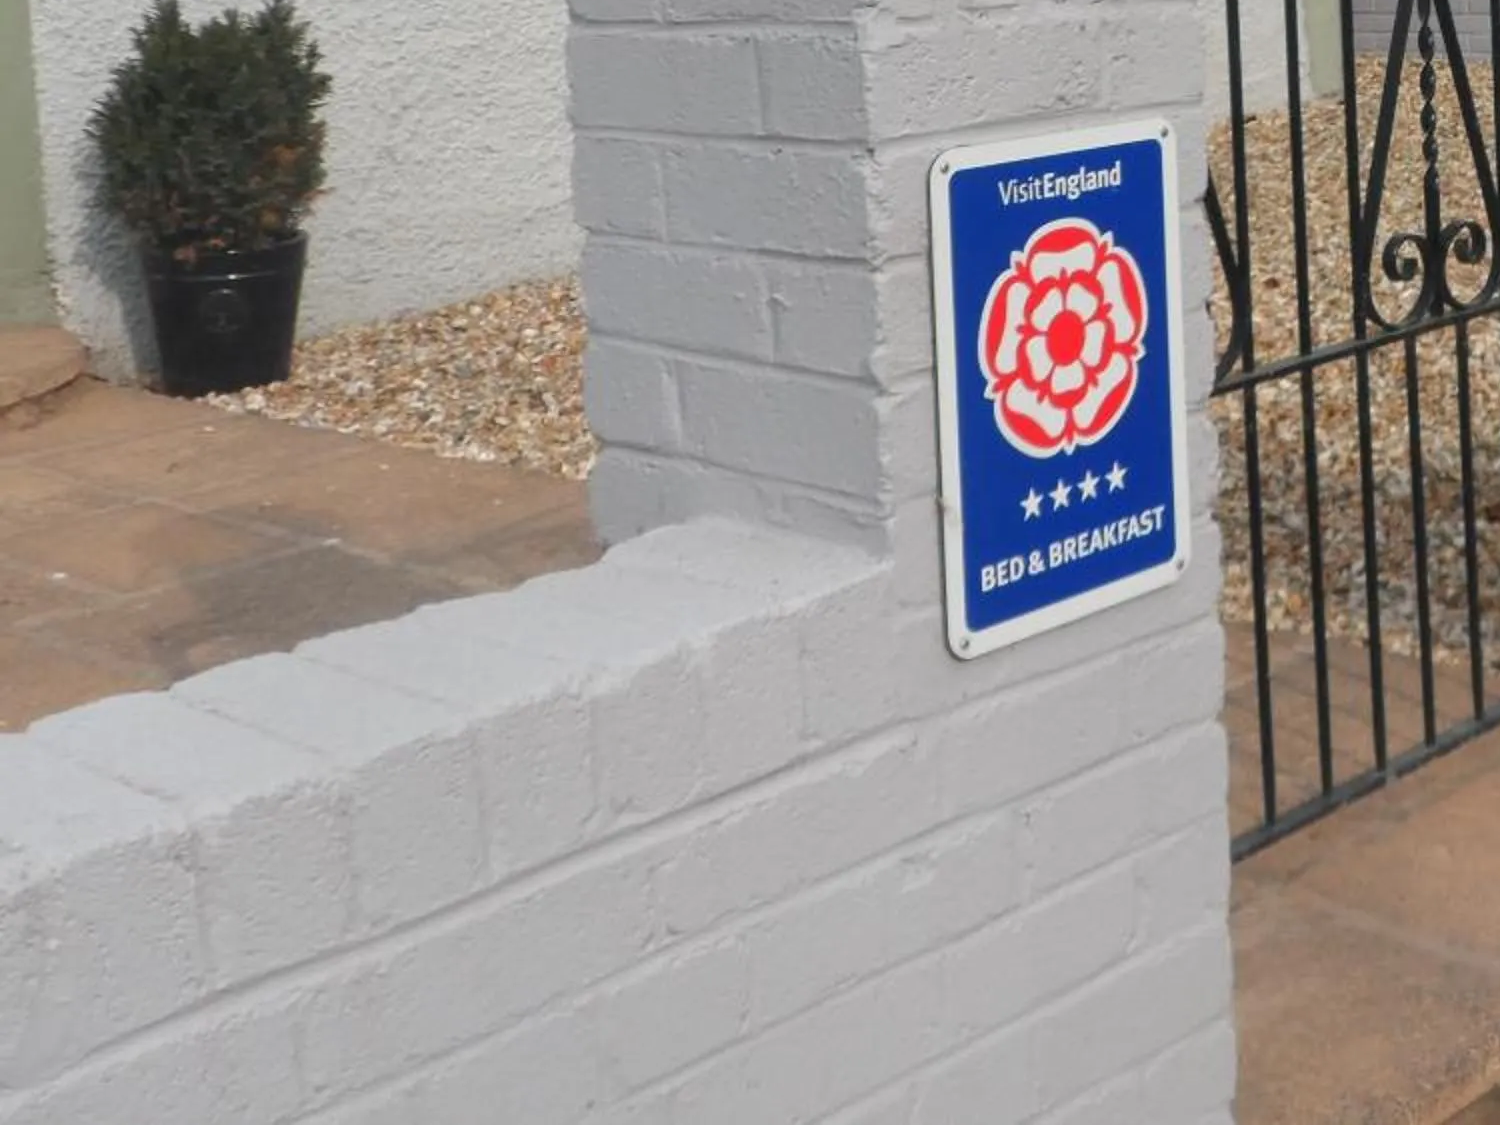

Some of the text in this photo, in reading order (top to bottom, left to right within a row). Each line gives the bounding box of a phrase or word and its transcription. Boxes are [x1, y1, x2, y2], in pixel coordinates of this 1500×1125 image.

[997, 160, 1121, 206] VisitEngland
[981, 504, 1166, 592] BED & BREAKFAST
